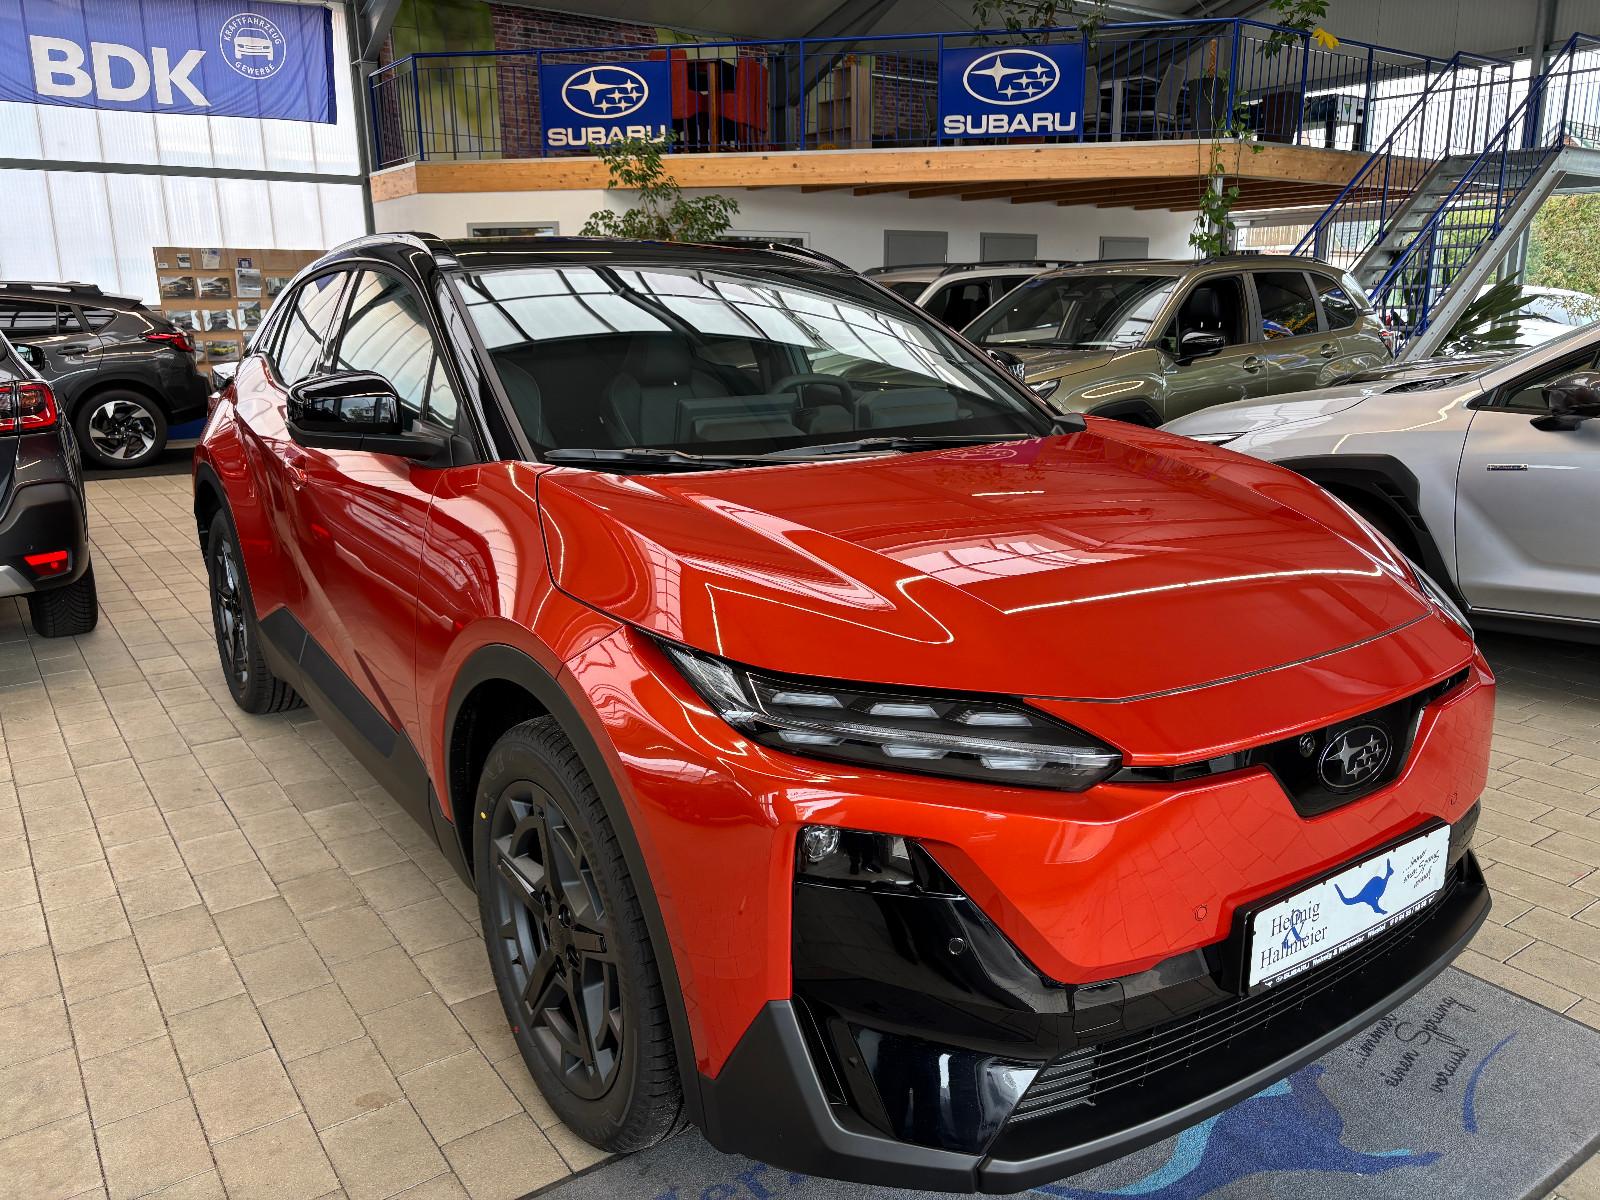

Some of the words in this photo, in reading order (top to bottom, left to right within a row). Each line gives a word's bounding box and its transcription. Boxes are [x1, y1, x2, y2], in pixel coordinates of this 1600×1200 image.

[223, 16, 282, 45] KRAFTFAHRZEUG
[29, 34, 212, 106] BDK
[235, 61, 275, 76] GEWERBE
[547, 124, 666, 146] SUBARU
[943, 111, 1077, 135] SUBARU
[1394, 996, 1477, 1046] Sprung
